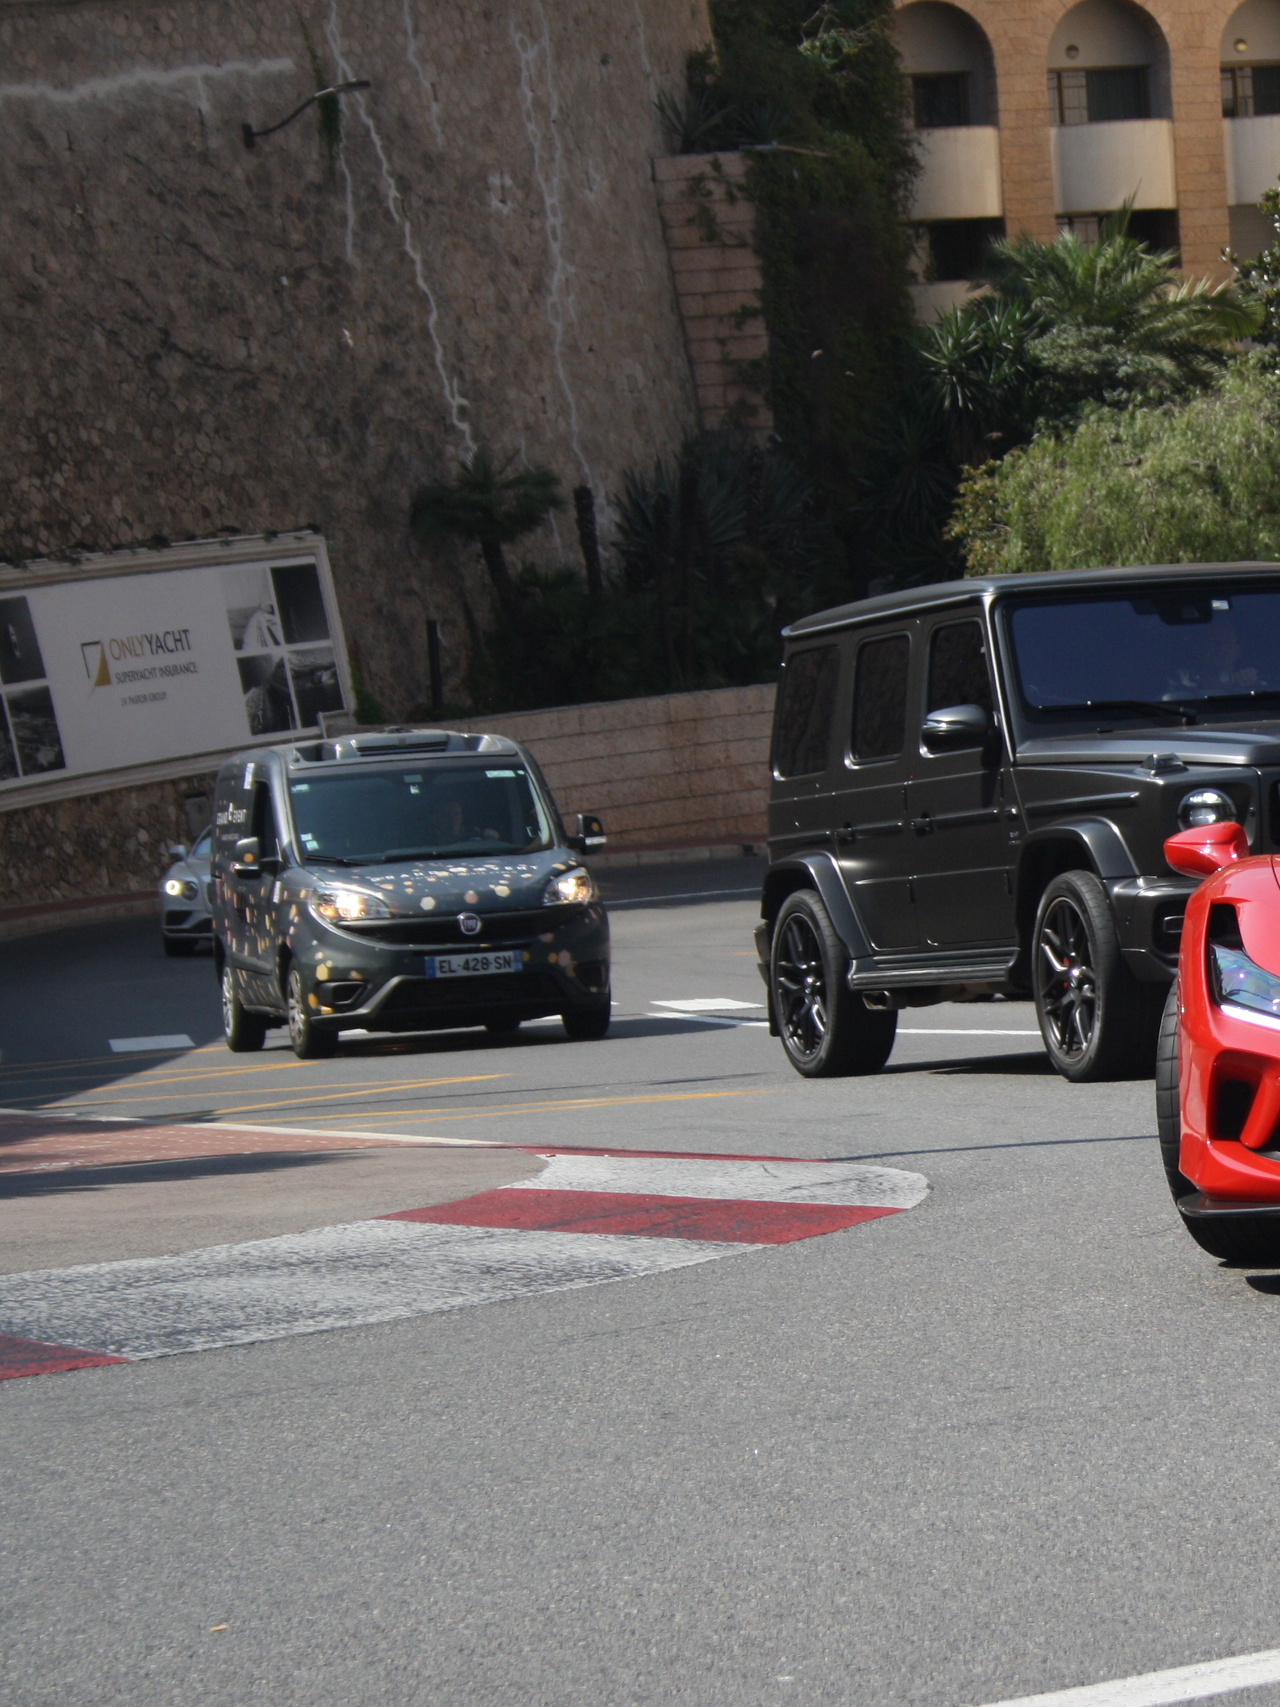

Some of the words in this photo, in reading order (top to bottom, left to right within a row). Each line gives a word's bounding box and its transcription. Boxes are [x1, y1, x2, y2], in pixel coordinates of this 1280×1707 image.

[115, 667, 157, 684] SUPERYACHT
[159, 661, 198, 677] INSURANCE
[438, 955, 511, 974] EL-428-SN
